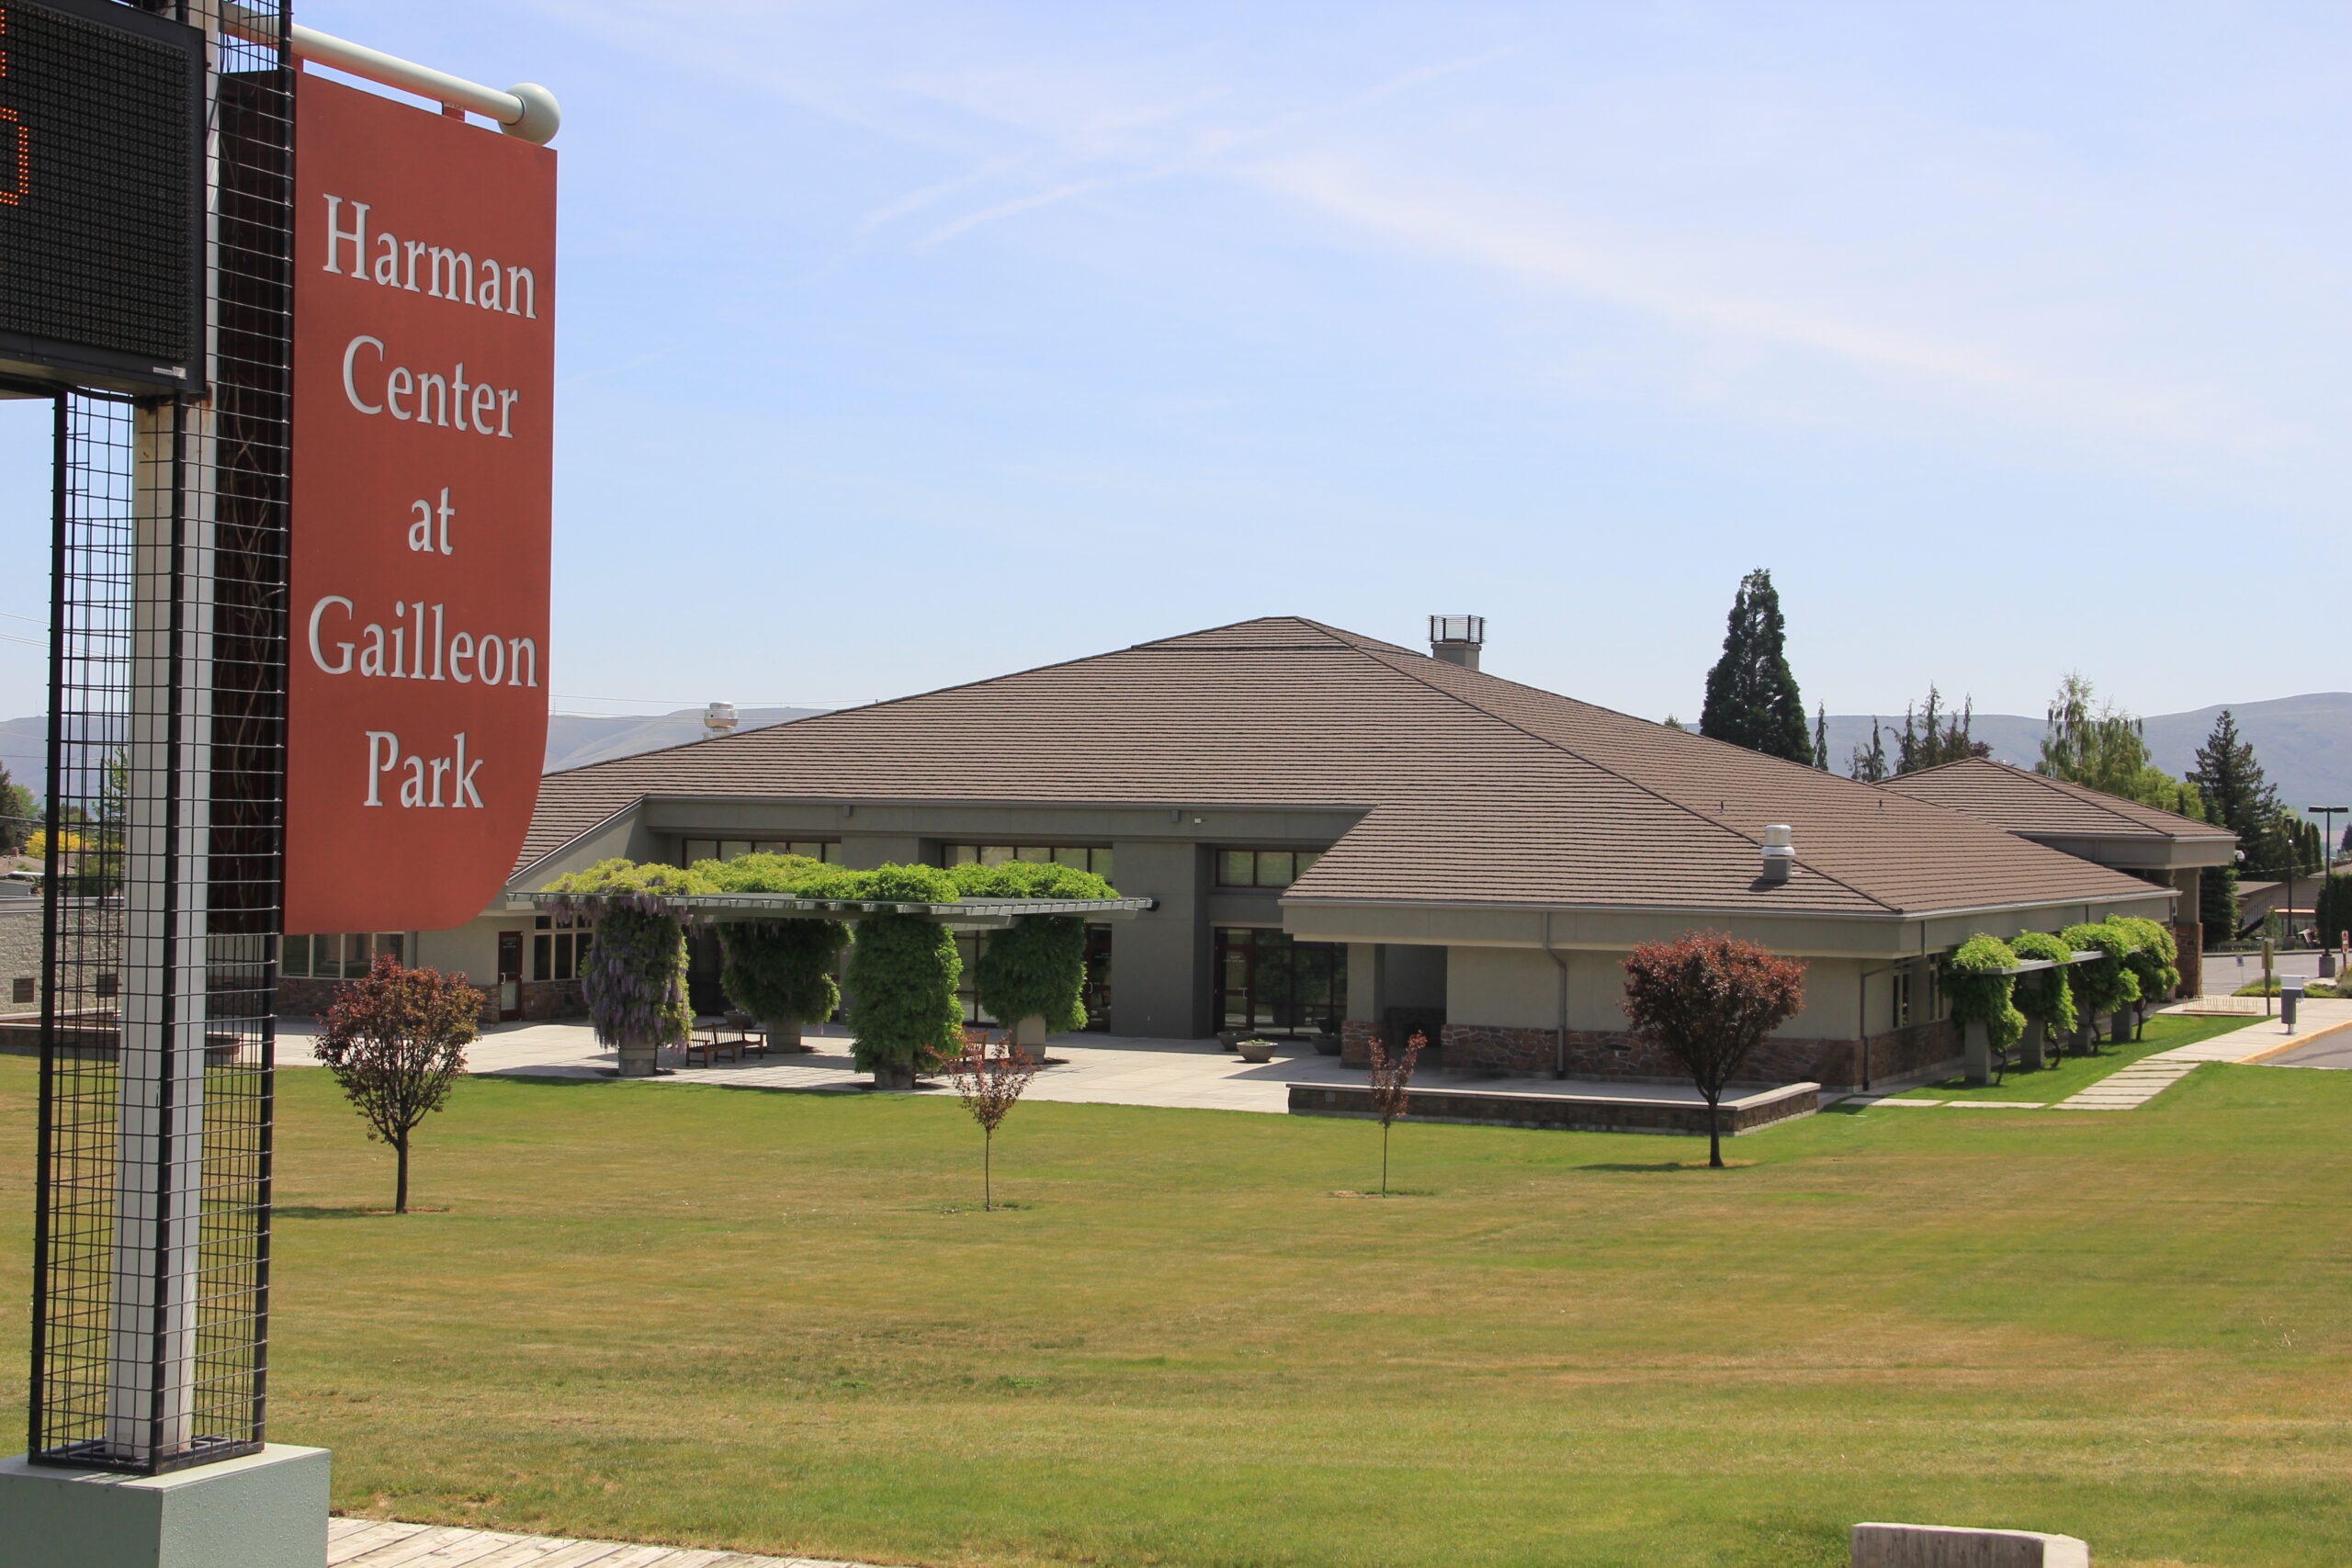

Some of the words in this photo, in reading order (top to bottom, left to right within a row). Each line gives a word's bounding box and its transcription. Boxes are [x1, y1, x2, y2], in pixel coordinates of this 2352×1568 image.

[322, 193, 537, 320] Harman
[343, 334, 519, 439] Center
[408, 487, 456, 556] at
[308, 594, 538, 688] Gailleon
[363, 730, 485, 809] Park
